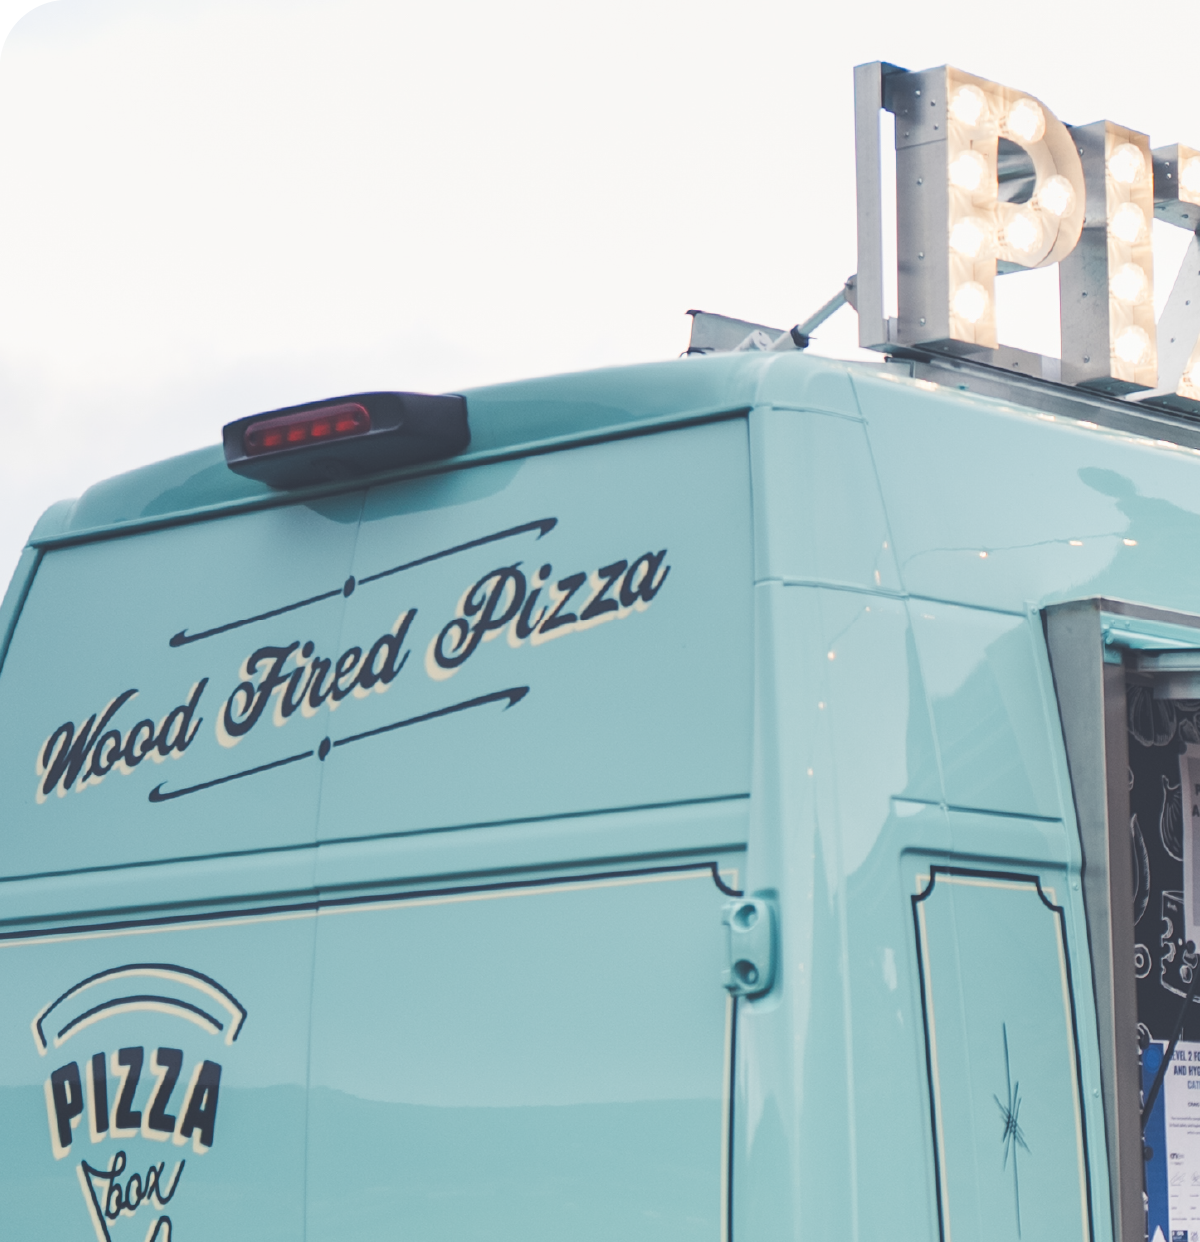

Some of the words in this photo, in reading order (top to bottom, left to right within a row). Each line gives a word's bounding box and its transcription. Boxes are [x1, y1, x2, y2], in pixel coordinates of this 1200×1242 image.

[36, 677, 209, 803] Wood
[215, 608, 417, 747] Fired
[425, 549, 670, 680] Pizza
[1192, 804, 1200, 817] A
[1173, 1065, 1187, 1076] AND
[1187, 1050, 1192, 1062] 2
[44, 1046, 222, 1160] PIZZA
[100, 1150, 186, 1226] box
